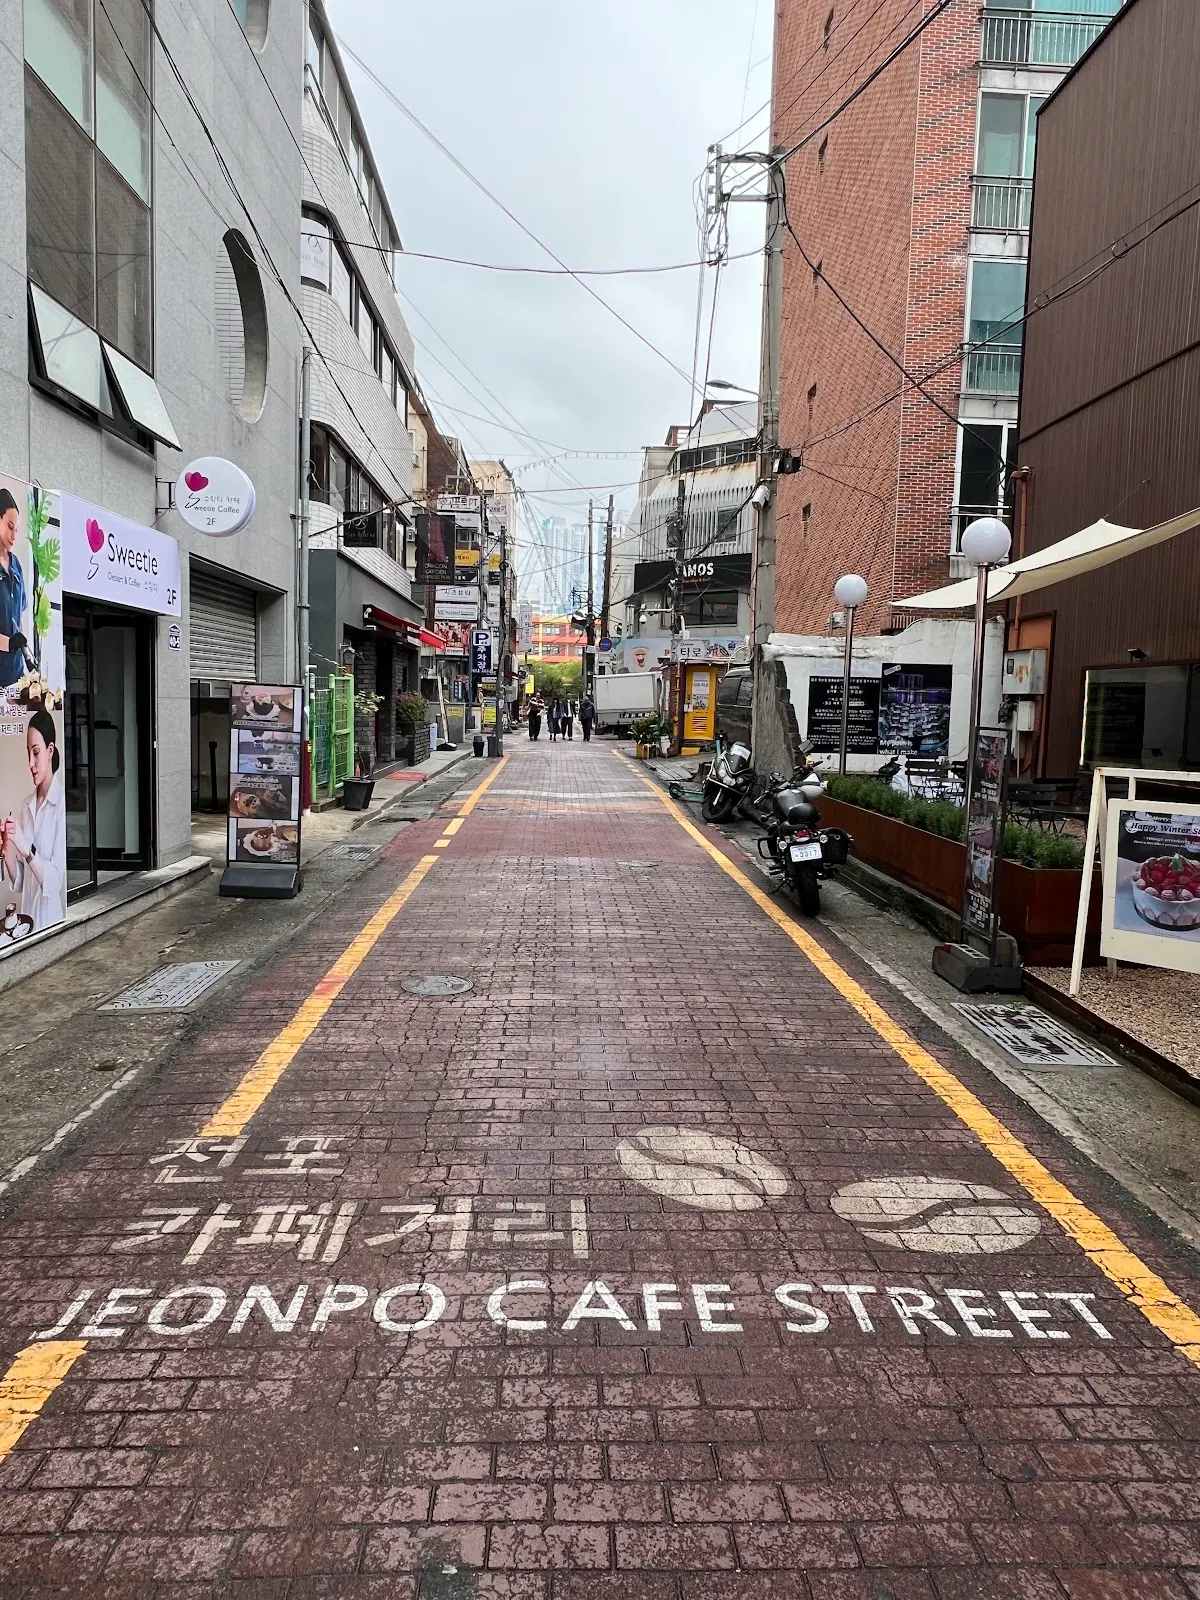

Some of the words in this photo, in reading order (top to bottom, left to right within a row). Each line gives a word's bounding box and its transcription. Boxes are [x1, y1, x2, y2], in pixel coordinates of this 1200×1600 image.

[218, 505, 240, 514] Coffee
[206, 517, 216, 526] 2F
[108, 533, 158, 576] Sweetie
[166, 588, 177, 606] 2F
[475, 632, 490, 645] P
[680, 647, 702, 658] 타로
[1130, 822, 1158, 833] Happy
[1160, 825, 1191, 835] Winter
[149, 1134, 346, 1184] 전포
[27, 1281, 447, 1341] JEONPO
[487, 1279, 744, 1335] CAFE
[774, 1282, 1115, 1342] STREET
